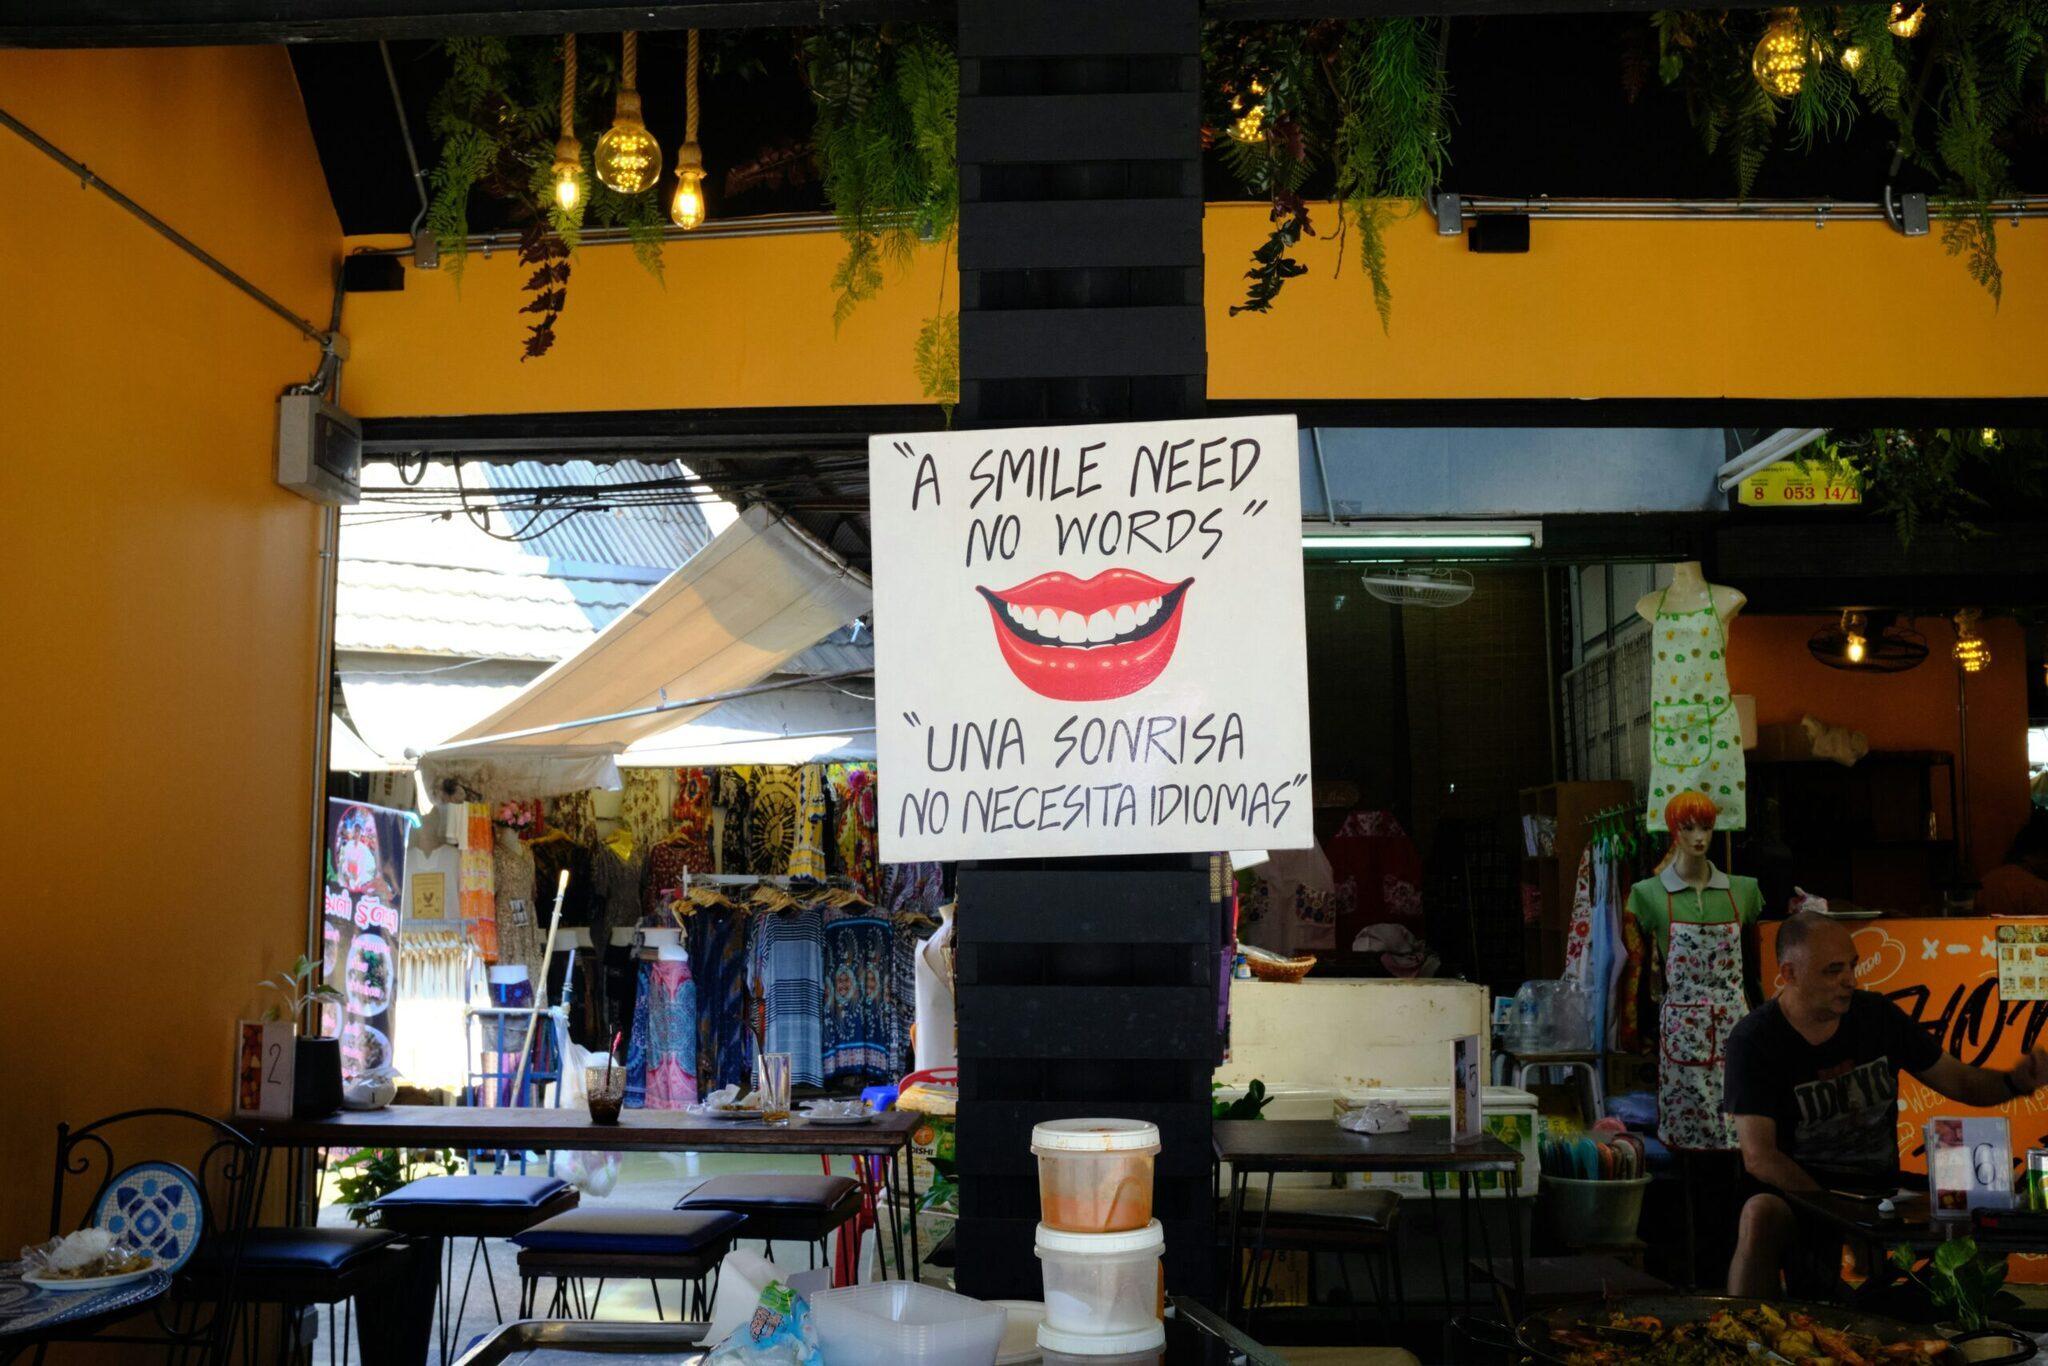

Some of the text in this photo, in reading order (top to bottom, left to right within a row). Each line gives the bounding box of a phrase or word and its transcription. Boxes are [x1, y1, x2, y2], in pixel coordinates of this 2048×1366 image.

[970, 441, 1106, 509] SMILE
[1130, 437, 1261, 497] NEED
[1754, 486, 1765, 500] 8
[1784, 486, 1815, 500] 053
[966, 513, 1021, 567] NO
[1055, 712, 1244, 769] SONRISA
[899, 788, 949, 838] NO
[962, 783, 1137, 834] NECESITA
[267, 1043, 282, 1085] 2
[1469, 1063, 1478, 1098] 5
[1973, 1142, 1996, 1186] 6
